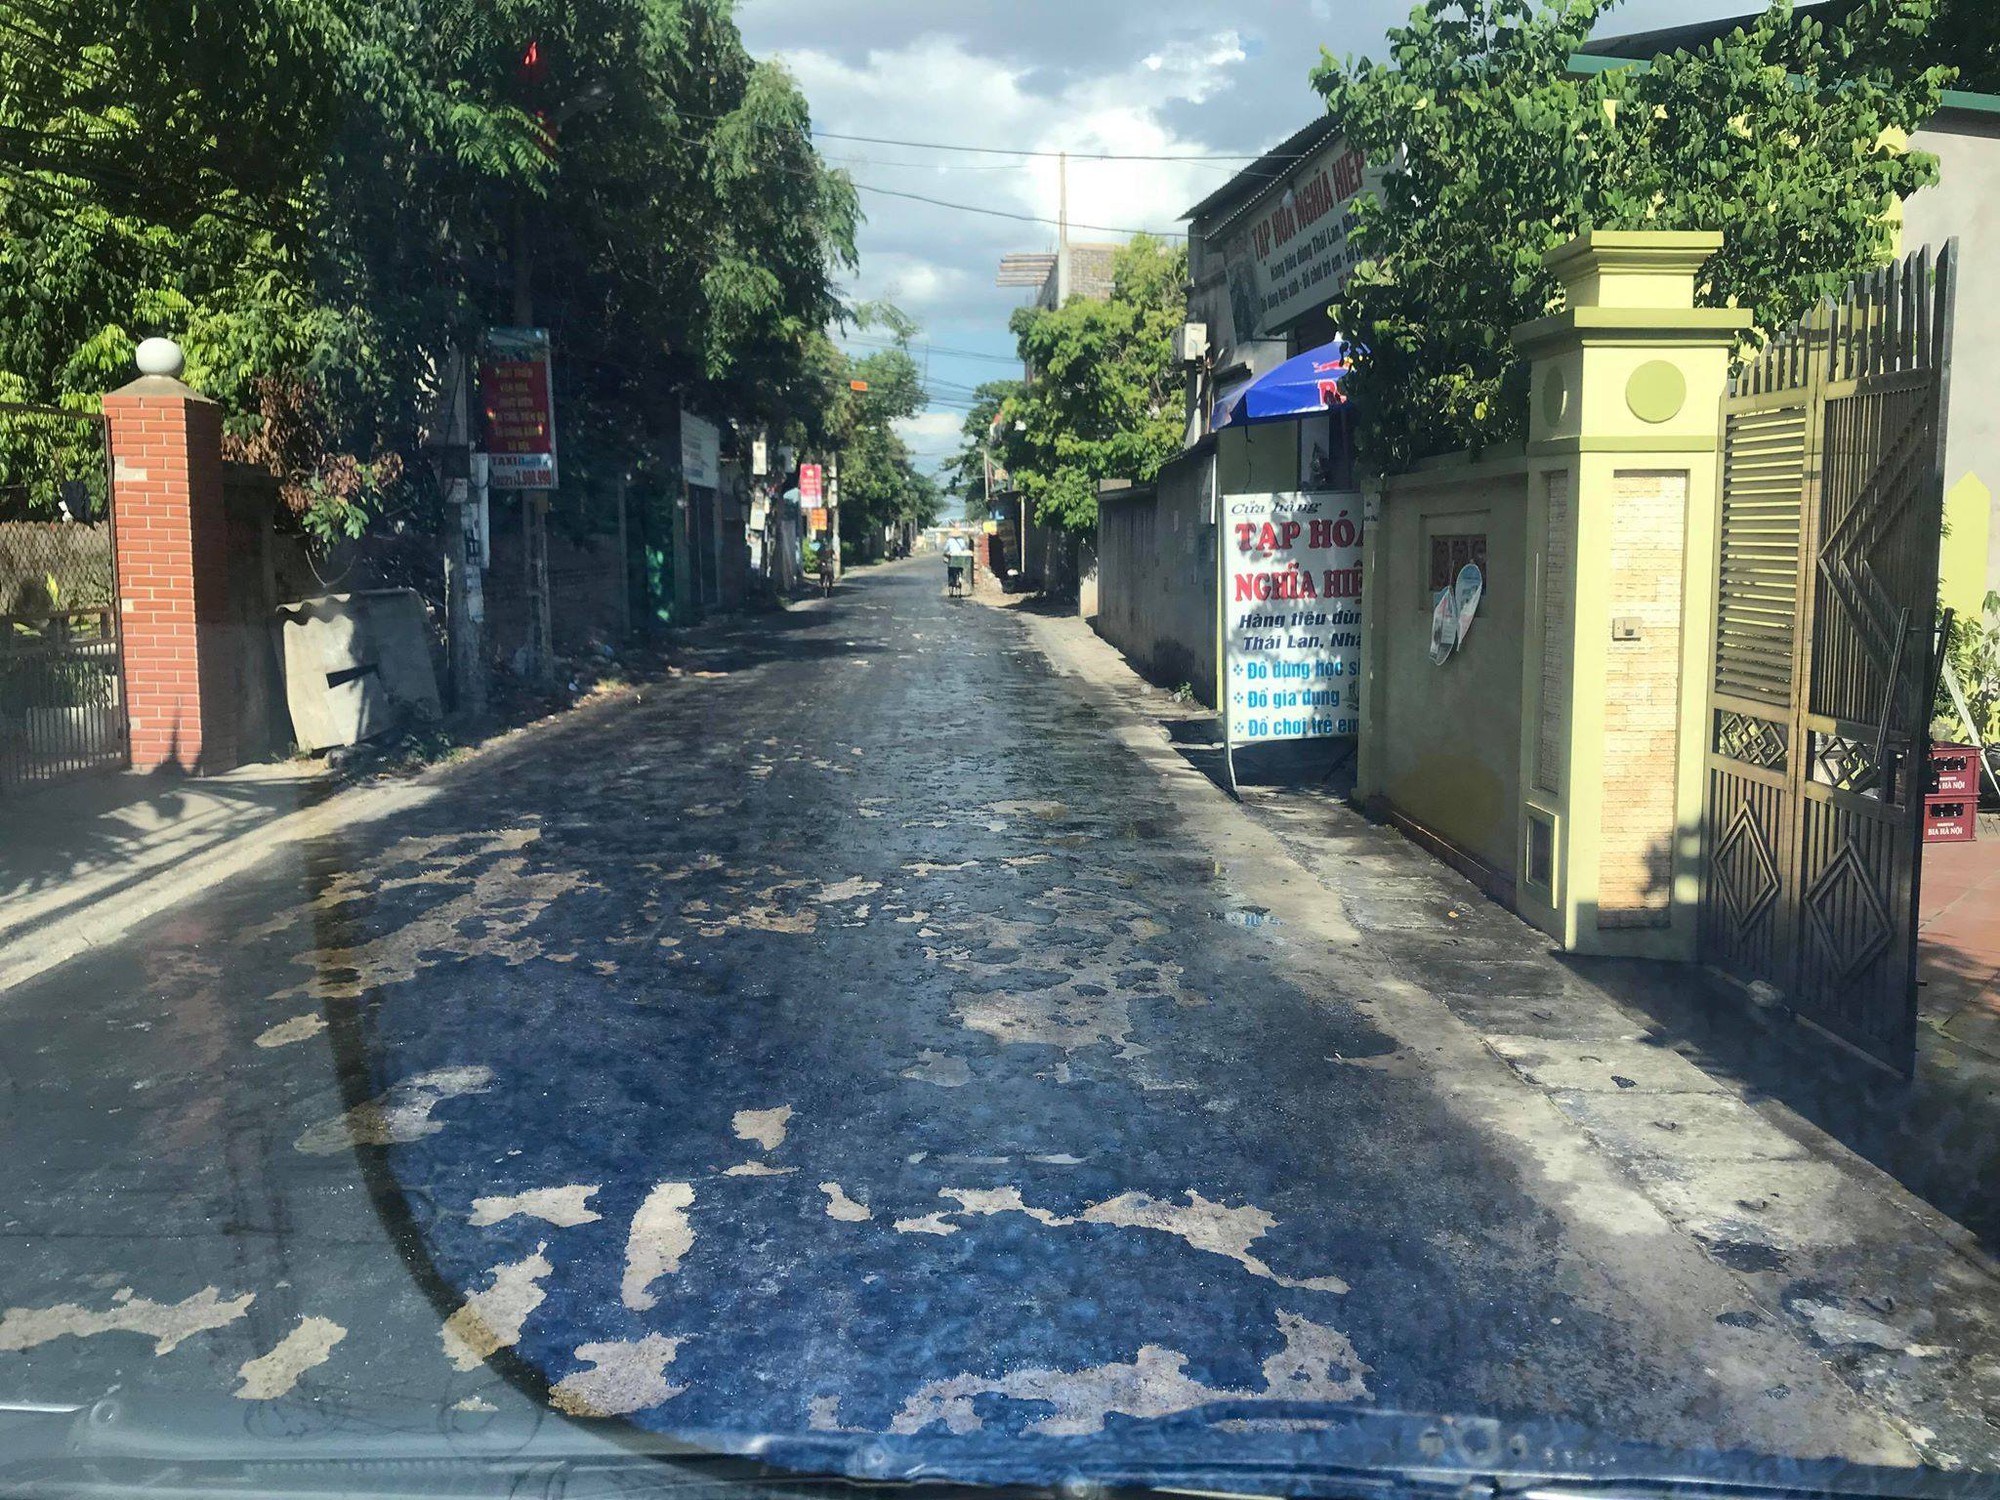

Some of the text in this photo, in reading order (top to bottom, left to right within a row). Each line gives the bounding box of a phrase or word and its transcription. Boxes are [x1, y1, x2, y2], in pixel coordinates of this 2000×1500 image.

[1272, 501, 1323, 514] hàng
[1235, 521, 1301, 558] TẠP
[1234, 562, 1318, 602] NGHĨA
[1239, 613, 1286, 628] Hàng
[1291, 611, 1327, 626] tiêu
[1243, 635, 1282, 651] Thái
[1287, 635, 1324, 649] Lan,
[1247, 658, 1268, 680] Đồ
[1272, 660, 1310, 680] dùng
[1315, 659, 1344, 681] học
[1247, 687, 1340, 710] Đồ gia dụng
[1248, 716, 1268, 737] Đồ
[1273, 718, 1307, 735] chơi
[1311, 713, 1333, 734] trẻ
